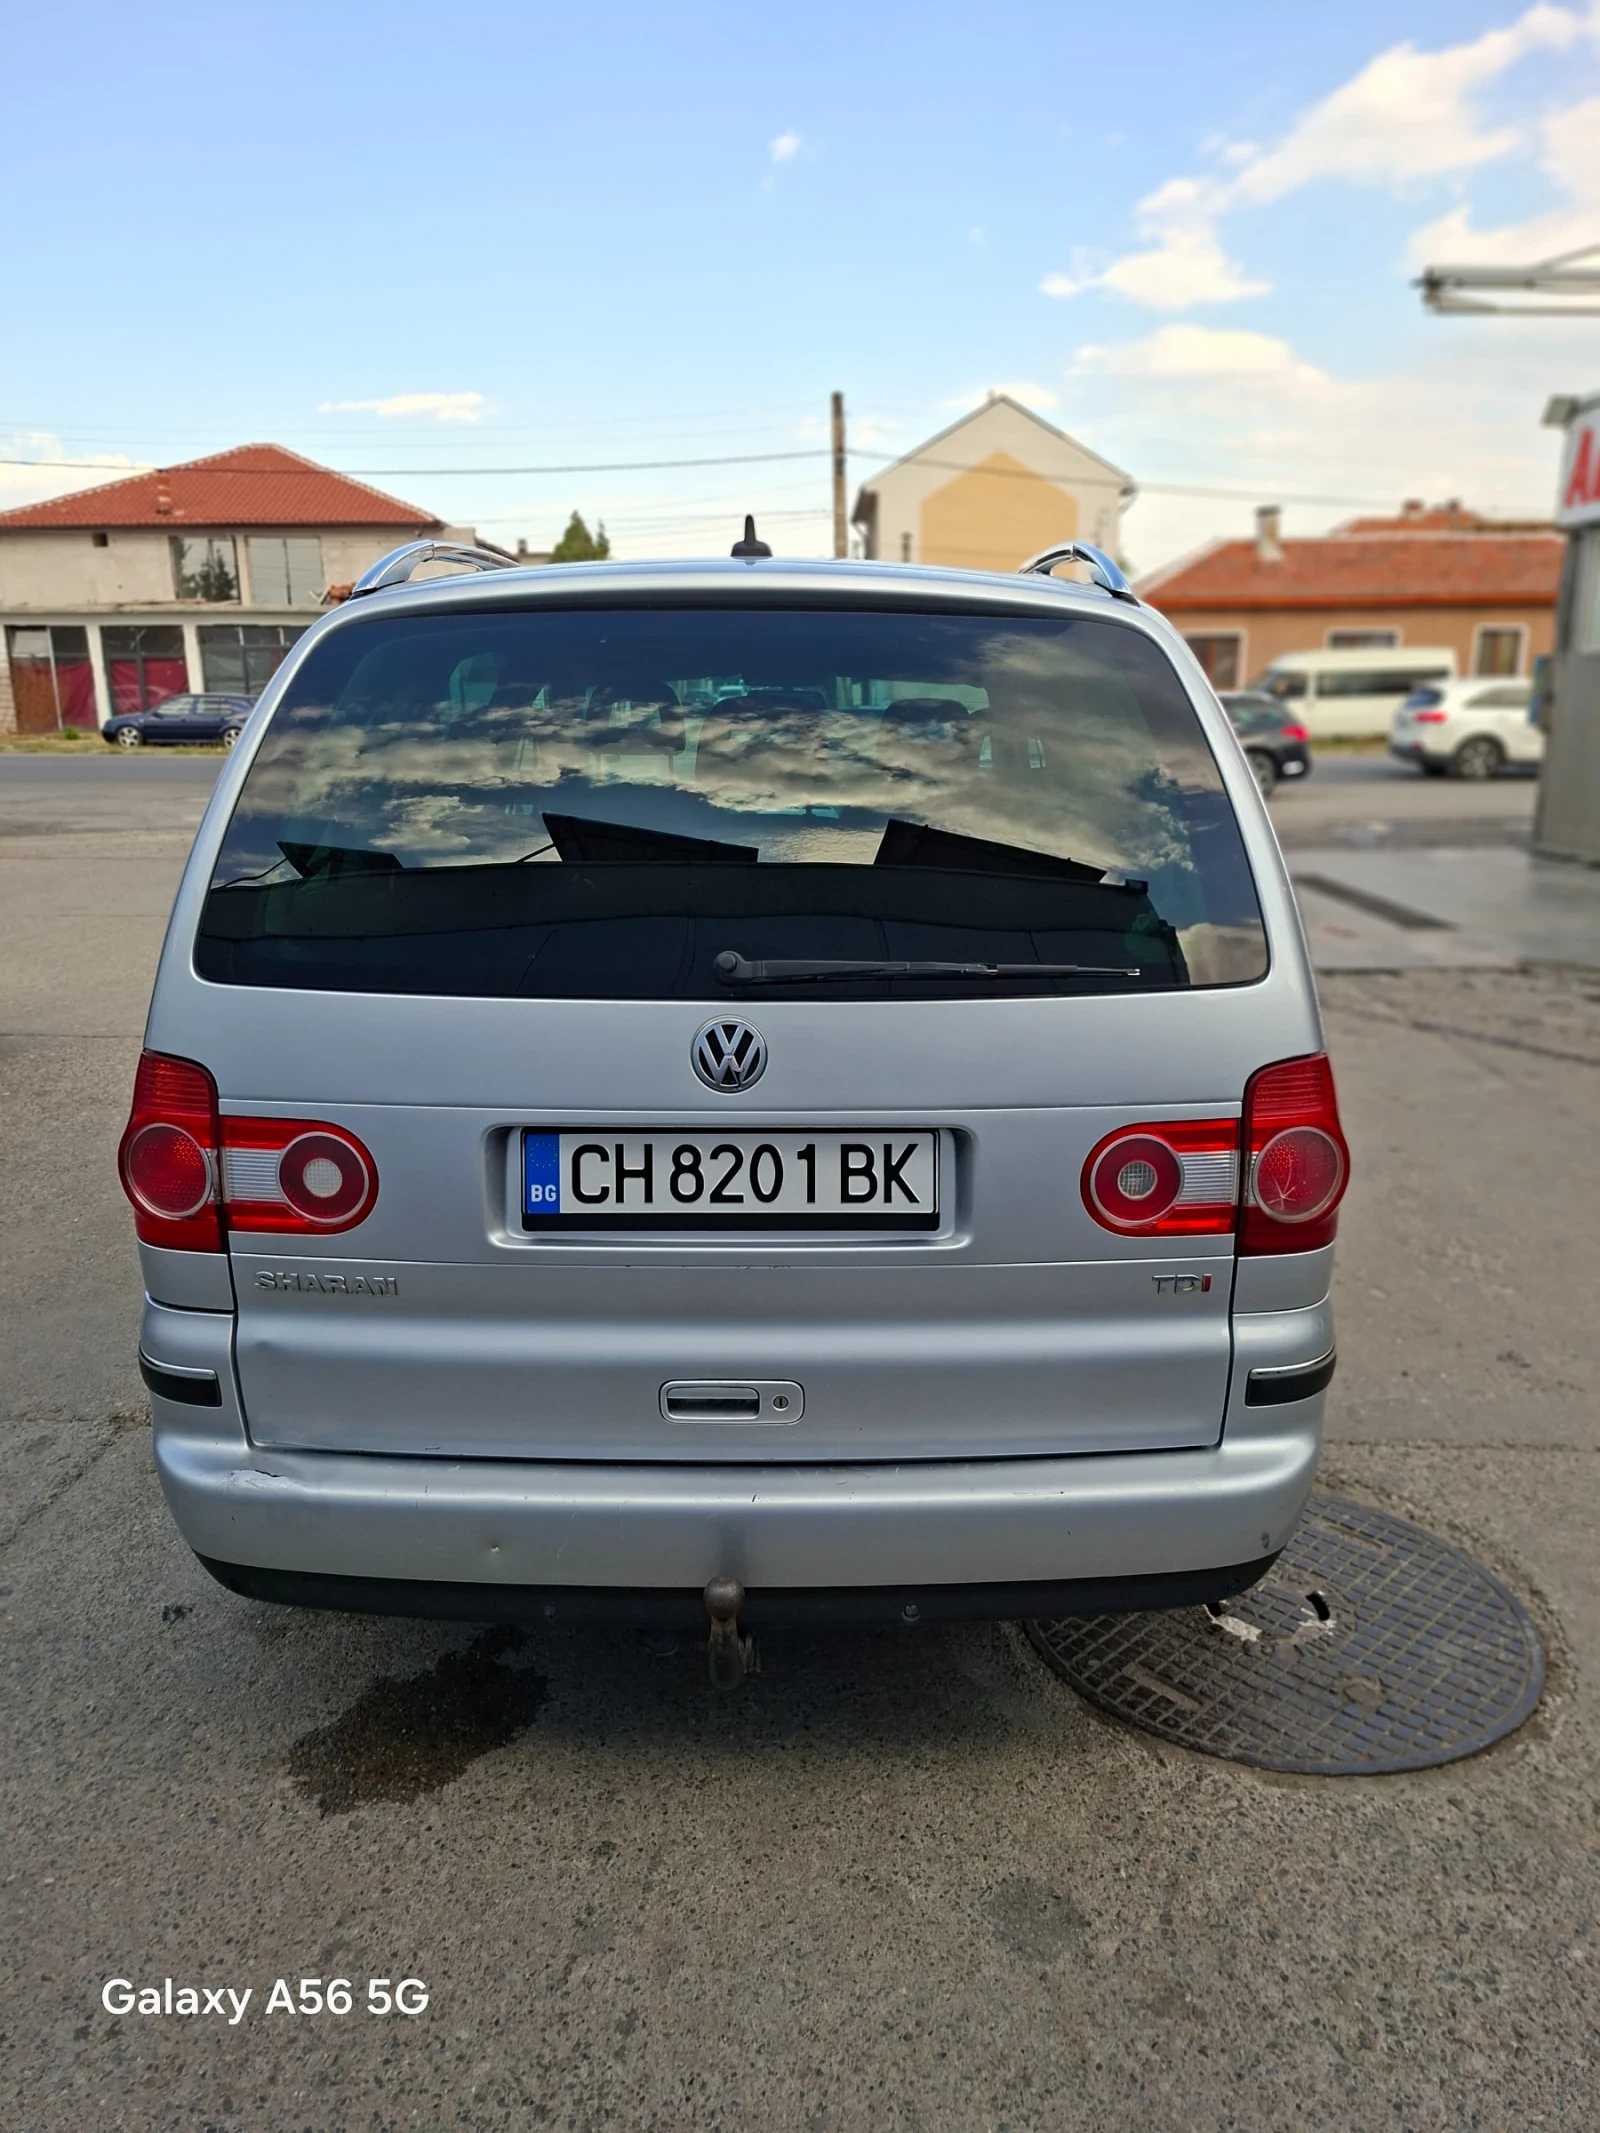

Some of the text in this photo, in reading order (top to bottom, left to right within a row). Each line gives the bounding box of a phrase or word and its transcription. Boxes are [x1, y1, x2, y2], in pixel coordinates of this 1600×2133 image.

[571, 1143, 920, 1204] CH 8201 BK
[531, 1184, 557, 1202] BG
[254, 1271, 398, 1296] SHARAN
